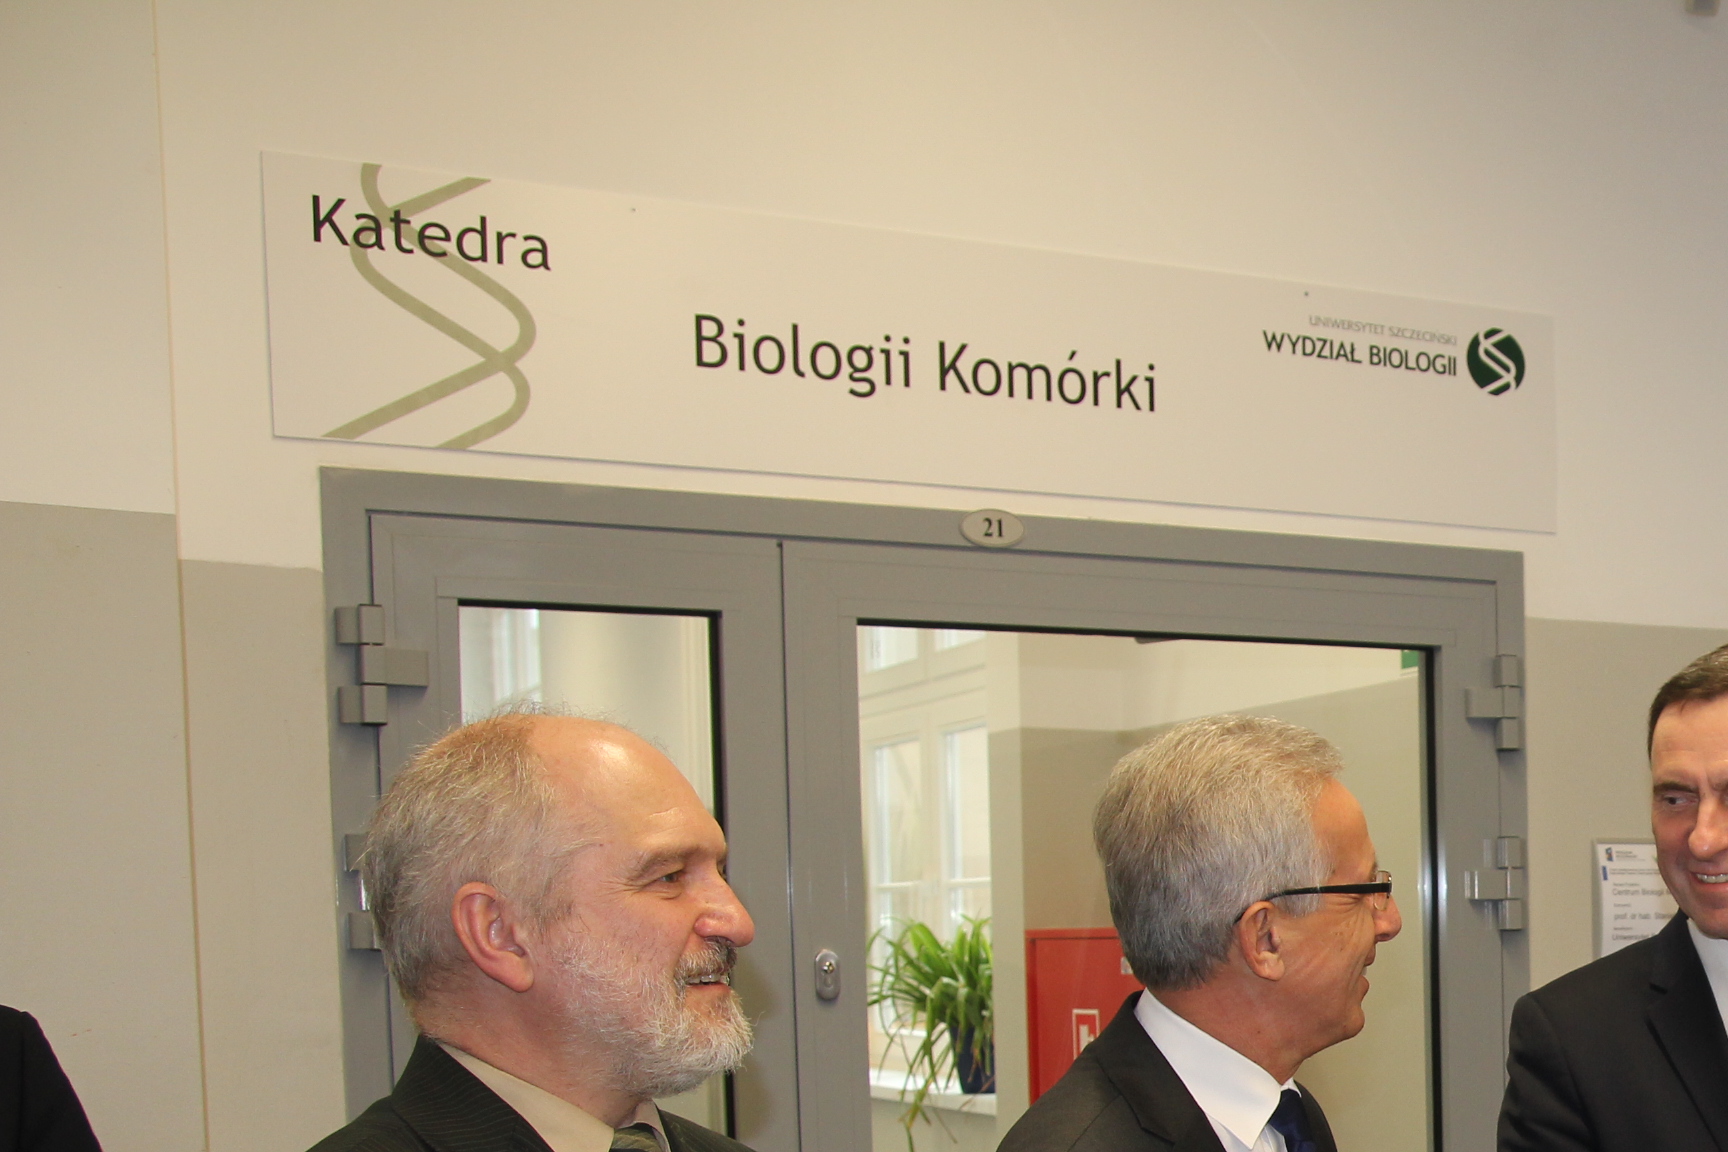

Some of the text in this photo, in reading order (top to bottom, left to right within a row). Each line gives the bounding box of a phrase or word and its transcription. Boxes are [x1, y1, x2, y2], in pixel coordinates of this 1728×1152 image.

[310, 194, 551, 271] Katedra
[1309, 315, 1385, 336] UNIWERSYTET
[694, 313, 1155, 413] Biologii Komórki
[1262, 329, 1458, 376] WYDZIAŁ BIOLOGII
[983, 517, 1003, 537] 21
